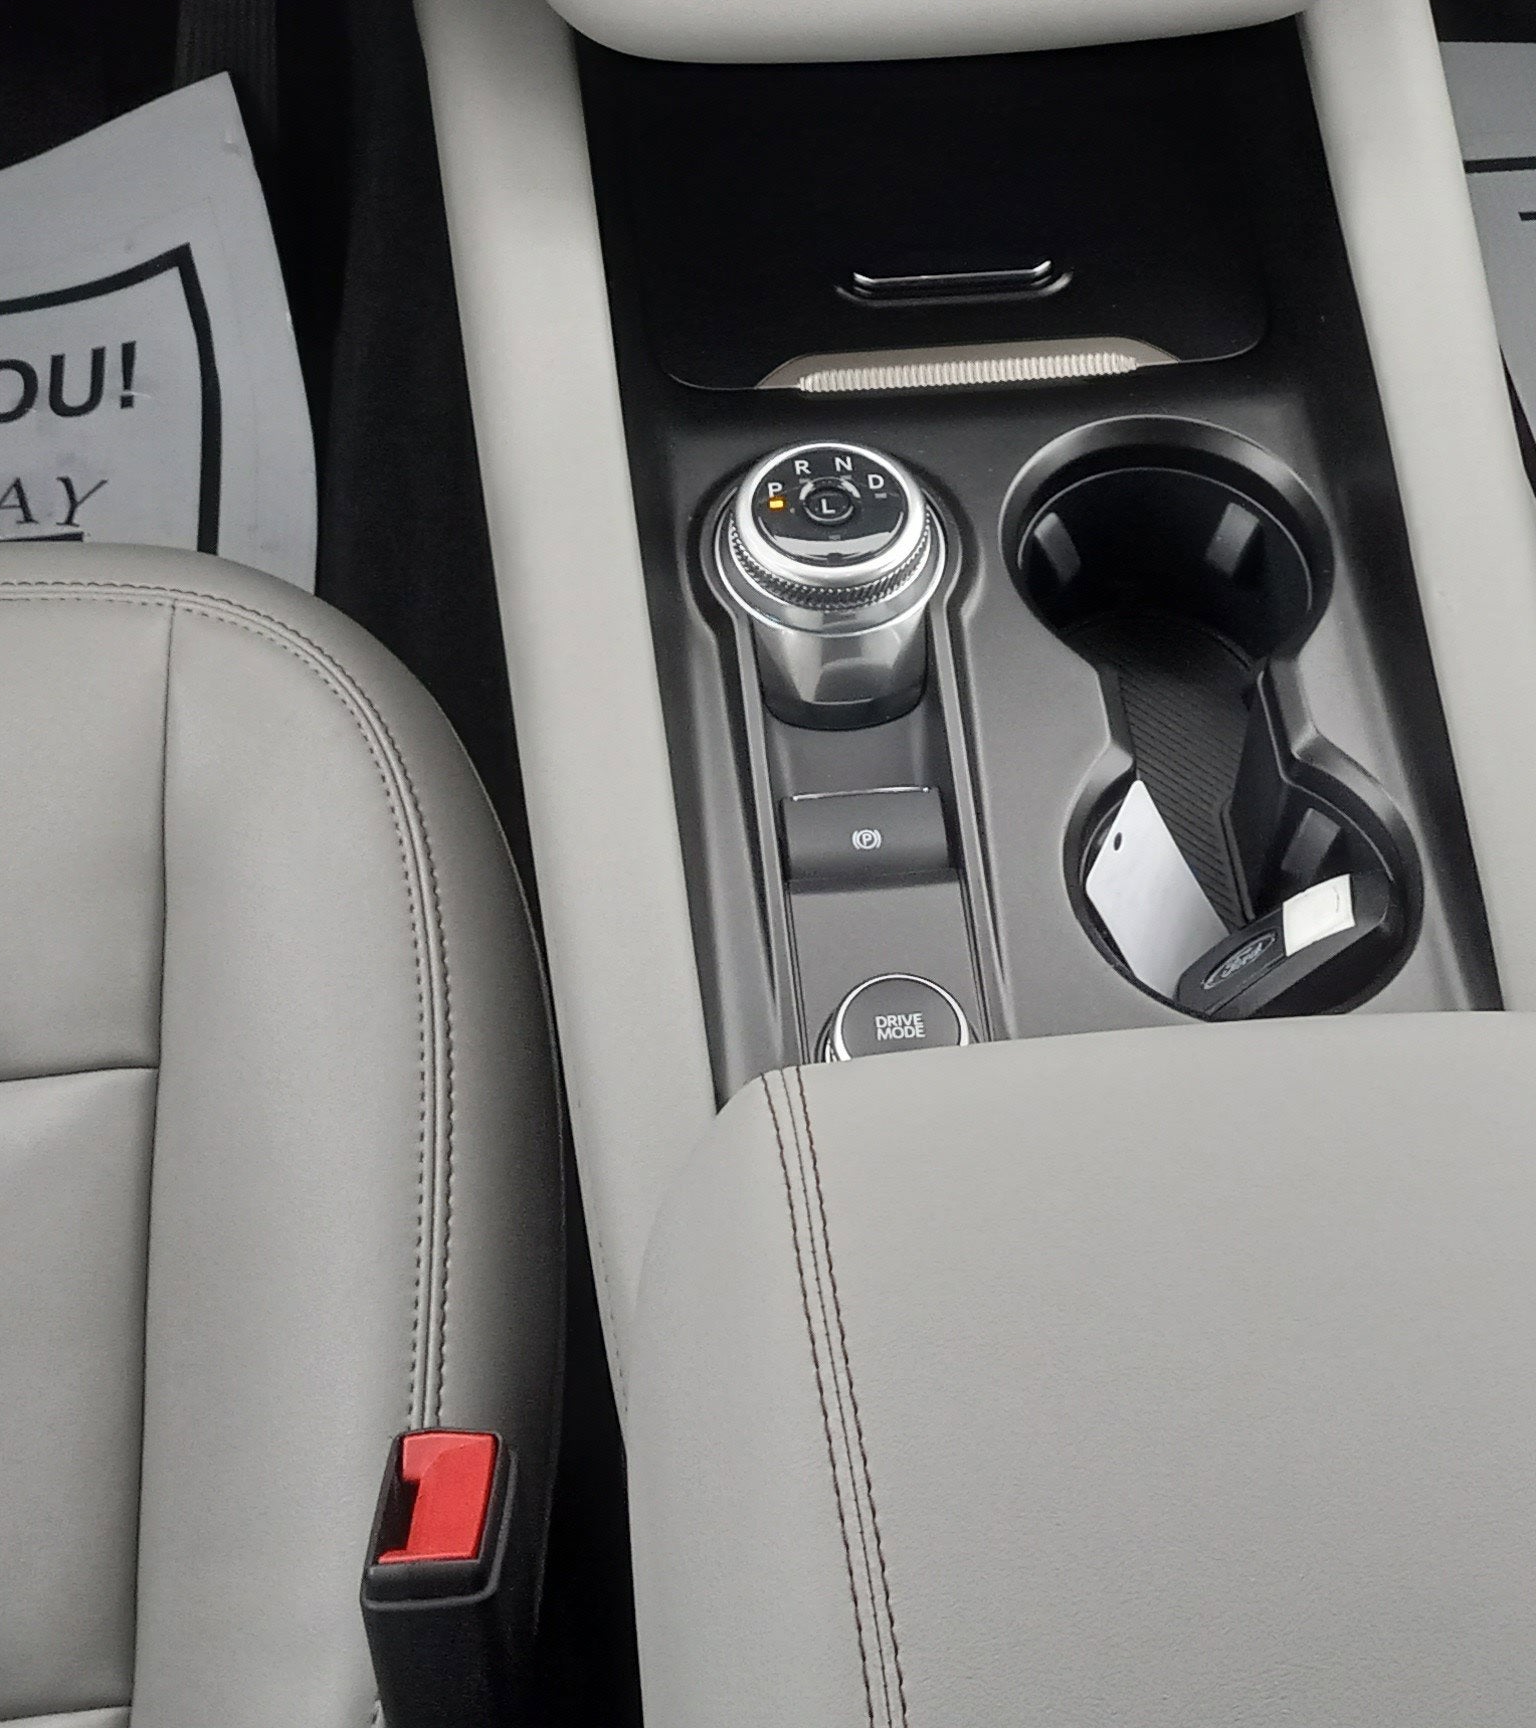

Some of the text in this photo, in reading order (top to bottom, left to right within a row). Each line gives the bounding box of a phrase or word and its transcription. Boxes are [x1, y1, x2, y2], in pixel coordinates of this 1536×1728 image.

[794, 456, 853, 475] R N
[767, 474, 885, 498] P D
[821, 498, 836, 514] L
[875, 1012, 923, 1029] DRIVE
[877, 1024, 926, 1041] MODE
